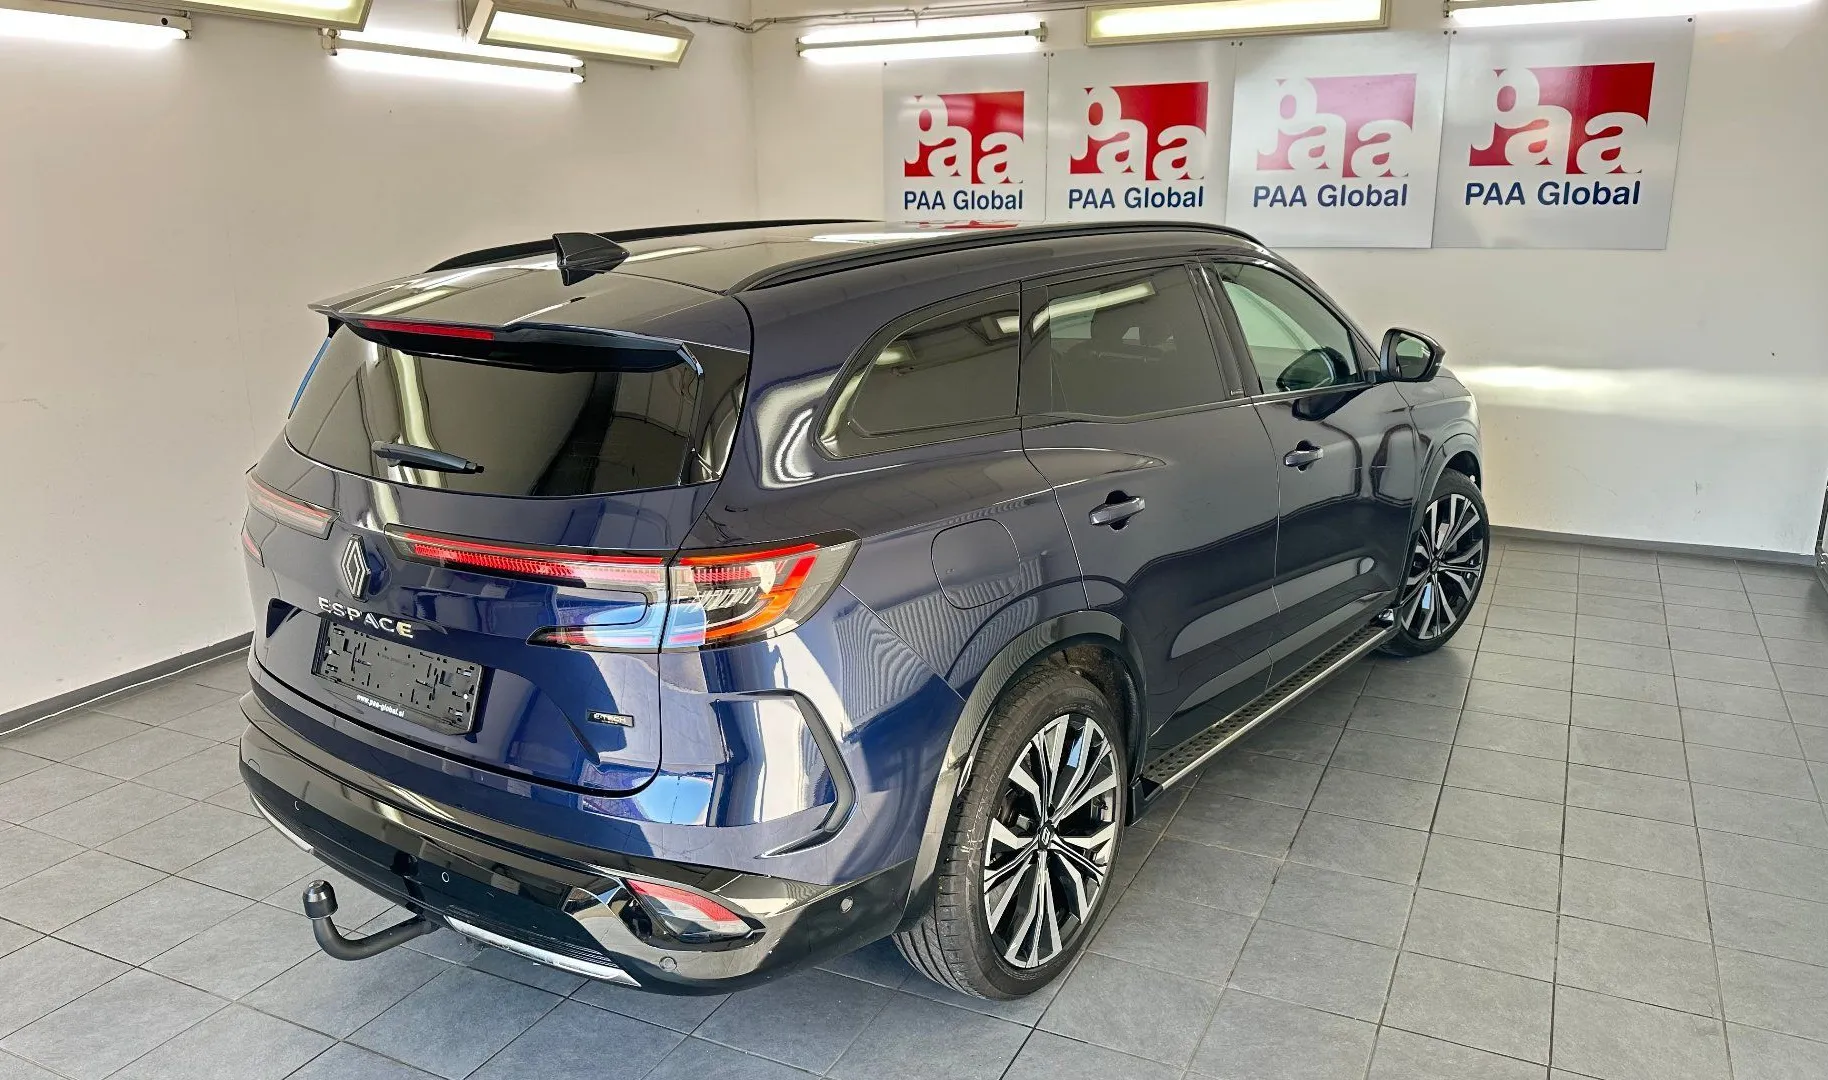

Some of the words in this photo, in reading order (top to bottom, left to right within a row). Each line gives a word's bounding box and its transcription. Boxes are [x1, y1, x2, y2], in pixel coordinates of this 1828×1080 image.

[904, 190, 946, 210] PAA
[953, 189, 1023, 210] Global
[1068, 188, 1116, 209] PAA
[1124, 186, 1204, 209] Global
[1253, 185, 1308, 208] PAA
[1317, 183, 1408, 207] Global
[1465, 181, 1526, 206] PAA
[1537, 180, 1641, 206] Global
[318, 596, 414, 639] ESPACE
